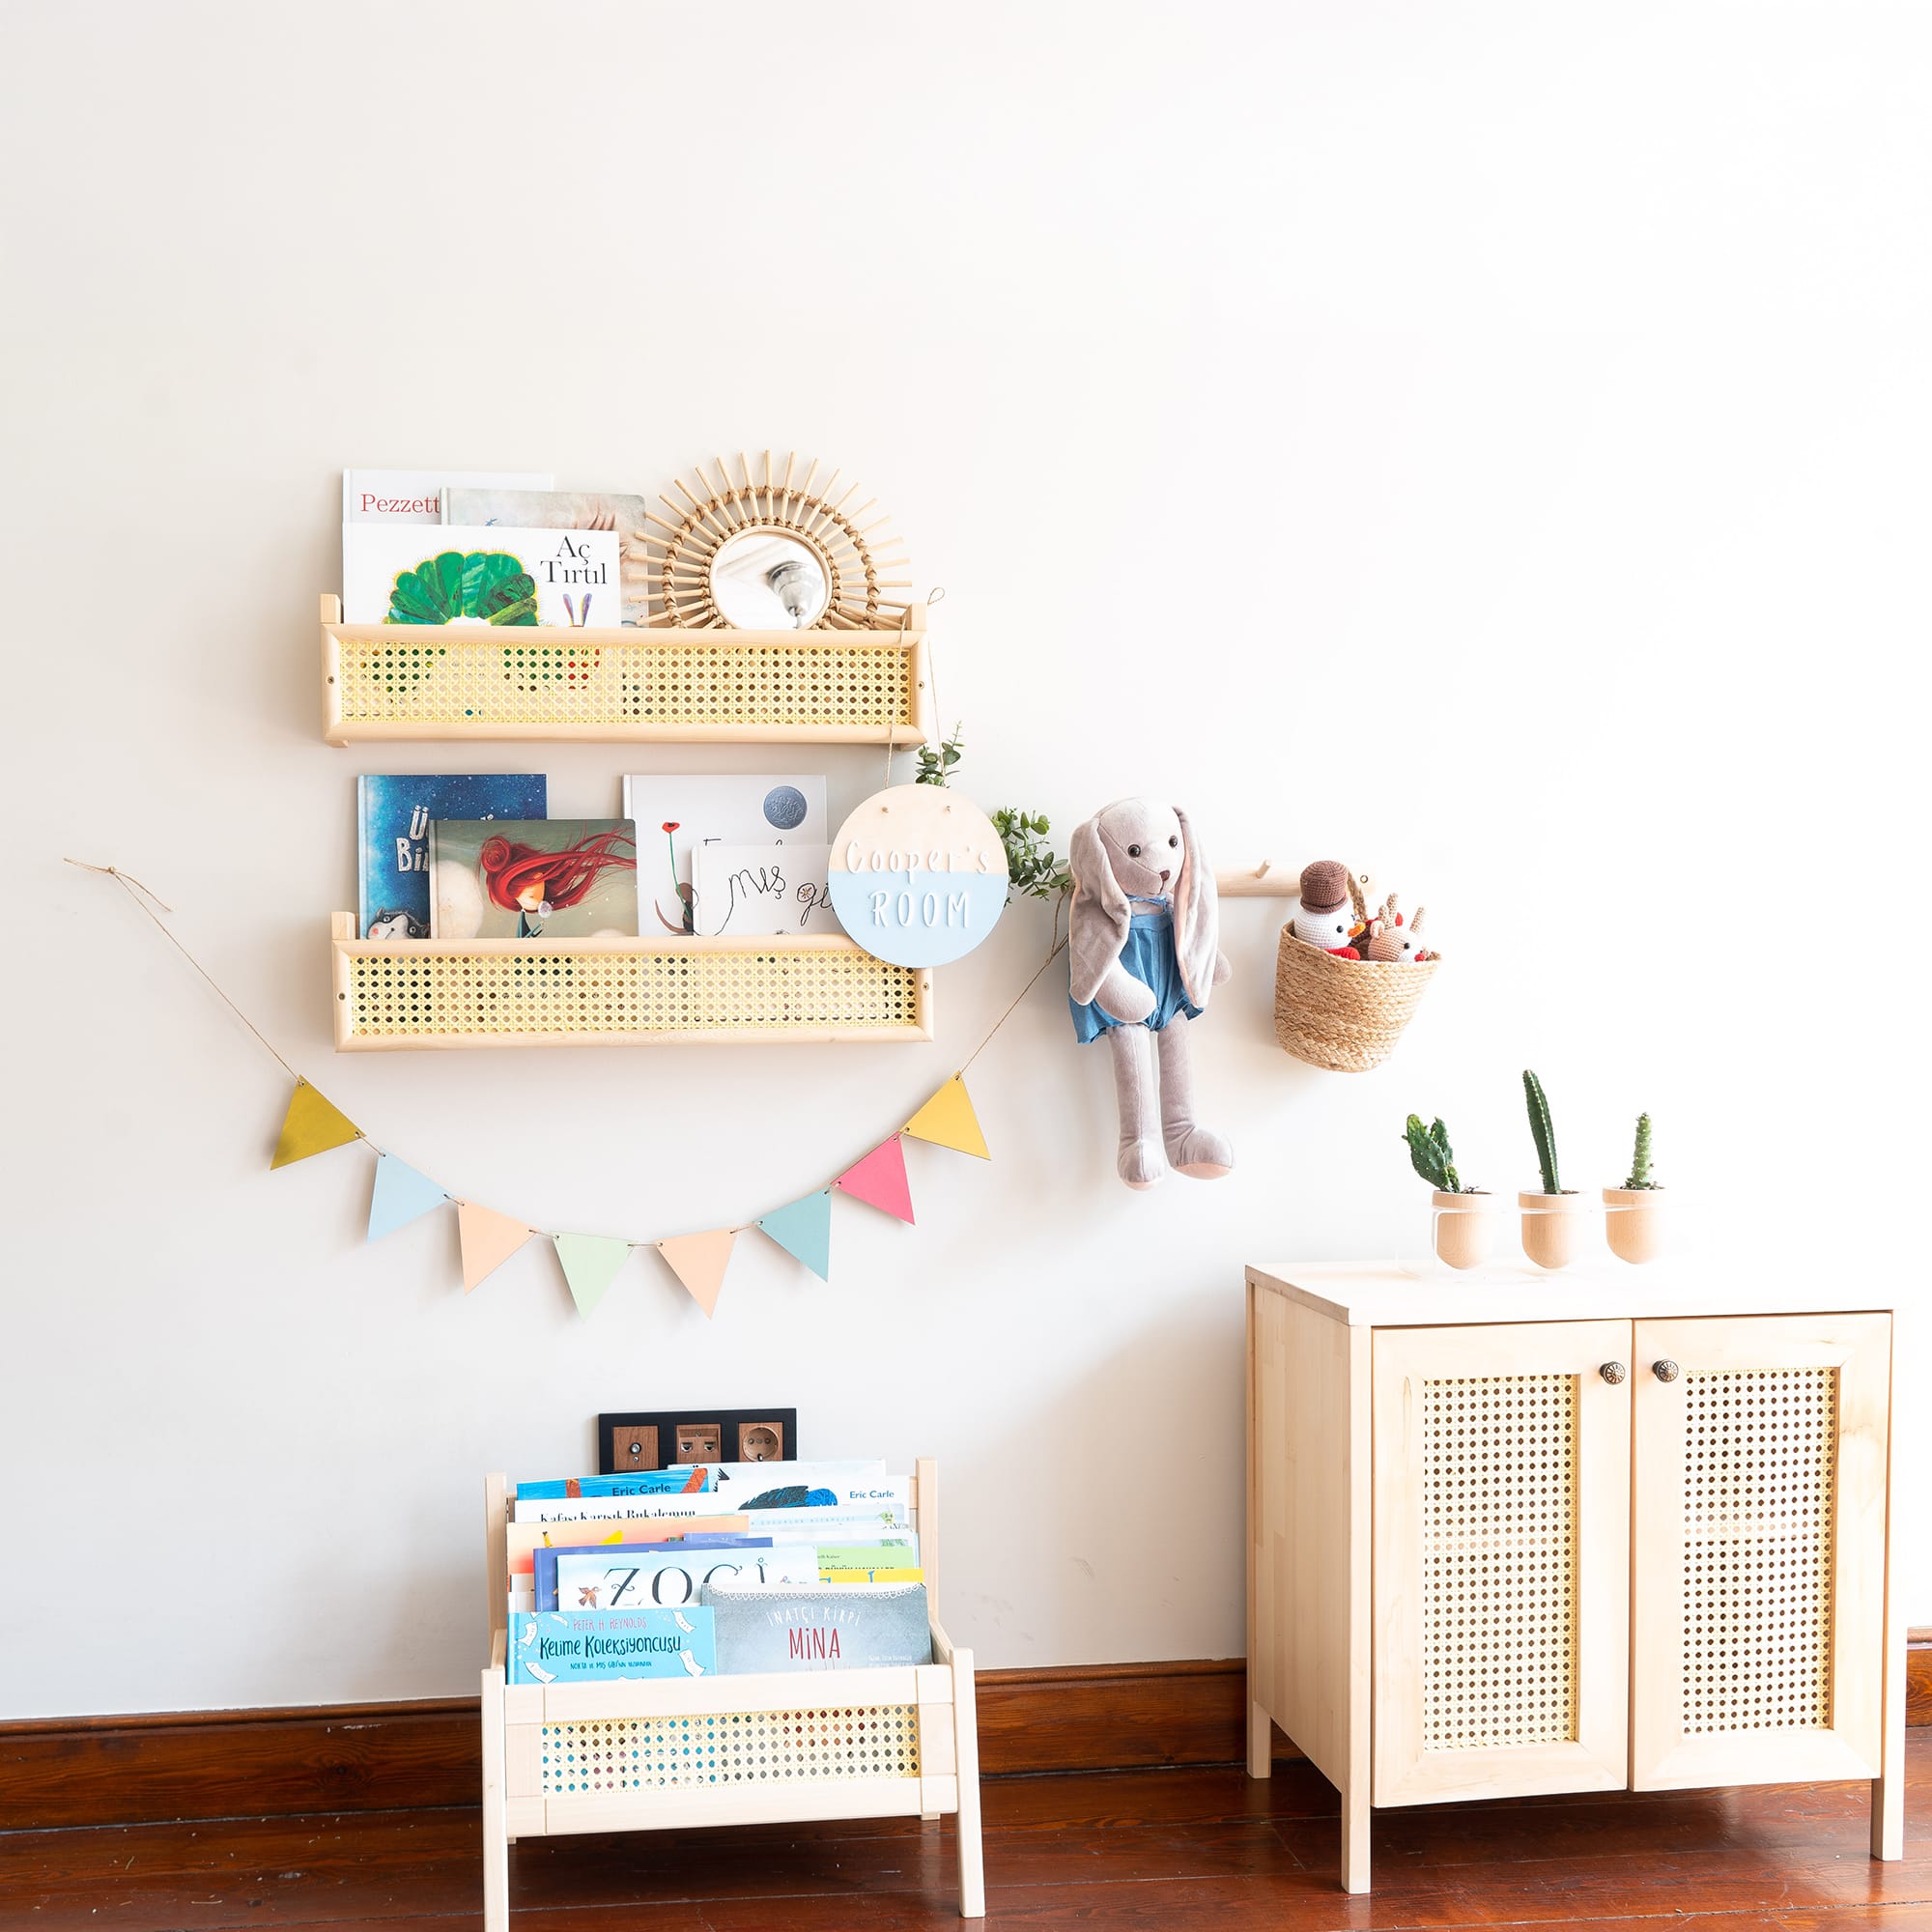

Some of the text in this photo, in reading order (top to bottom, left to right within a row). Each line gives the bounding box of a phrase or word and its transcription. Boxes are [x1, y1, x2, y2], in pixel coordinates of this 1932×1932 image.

[555, 535, 590, 564] Aç
[540, 560, 608, 584] Tırtıl
[409, 805, 430, 840] Ü
[845, 838, 990, 884] Cooper's
[869, 890, 970, 928] ROOM
[611, 1484, 671, 1497] Eric Carle
[849, 1491, 867, 1499] Eric
[573, 1618, 595, 1631] PETER
[610, 1617, 647, 1631] REYNOLDS
[765, 1606, 814, 1627] İNATÇI
[540, 1634, 681, 1660] Kelime Koleksiyoncusu
